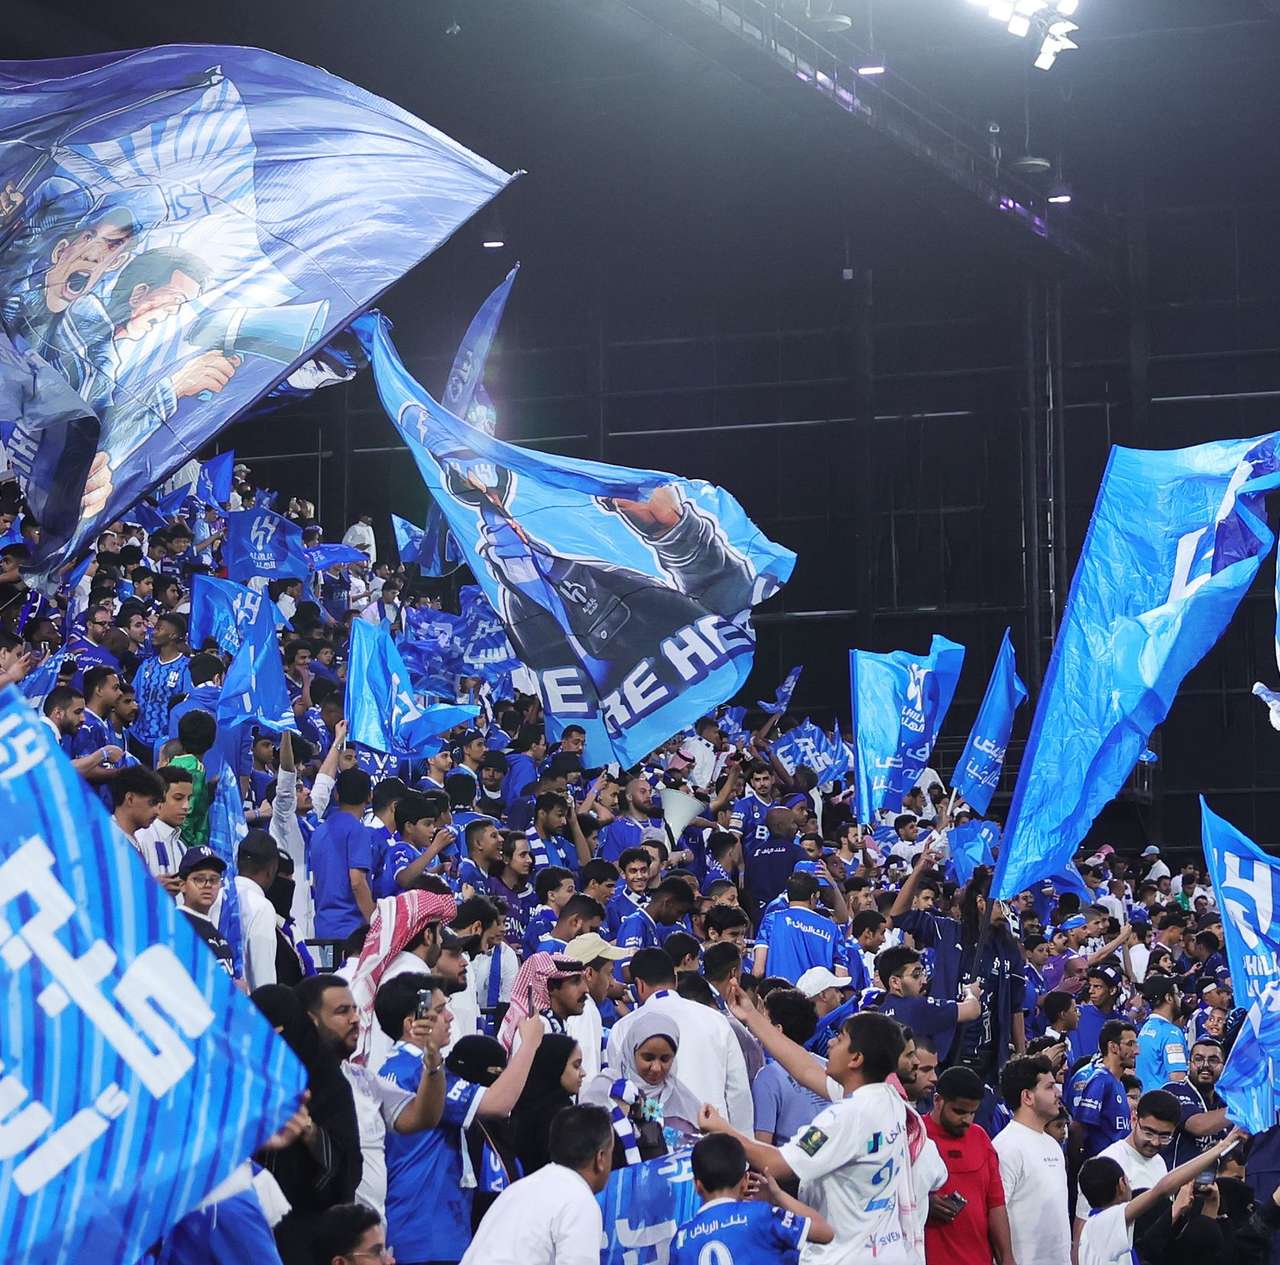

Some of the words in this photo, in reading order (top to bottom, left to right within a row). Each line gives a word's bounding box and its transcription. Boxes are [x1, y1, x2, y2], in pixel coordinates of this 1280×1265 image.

[601, 660, 669, 734] RE
[689, 1220, 719, 1239] الرياض
[721, 1215, 748, 1228] بنك
